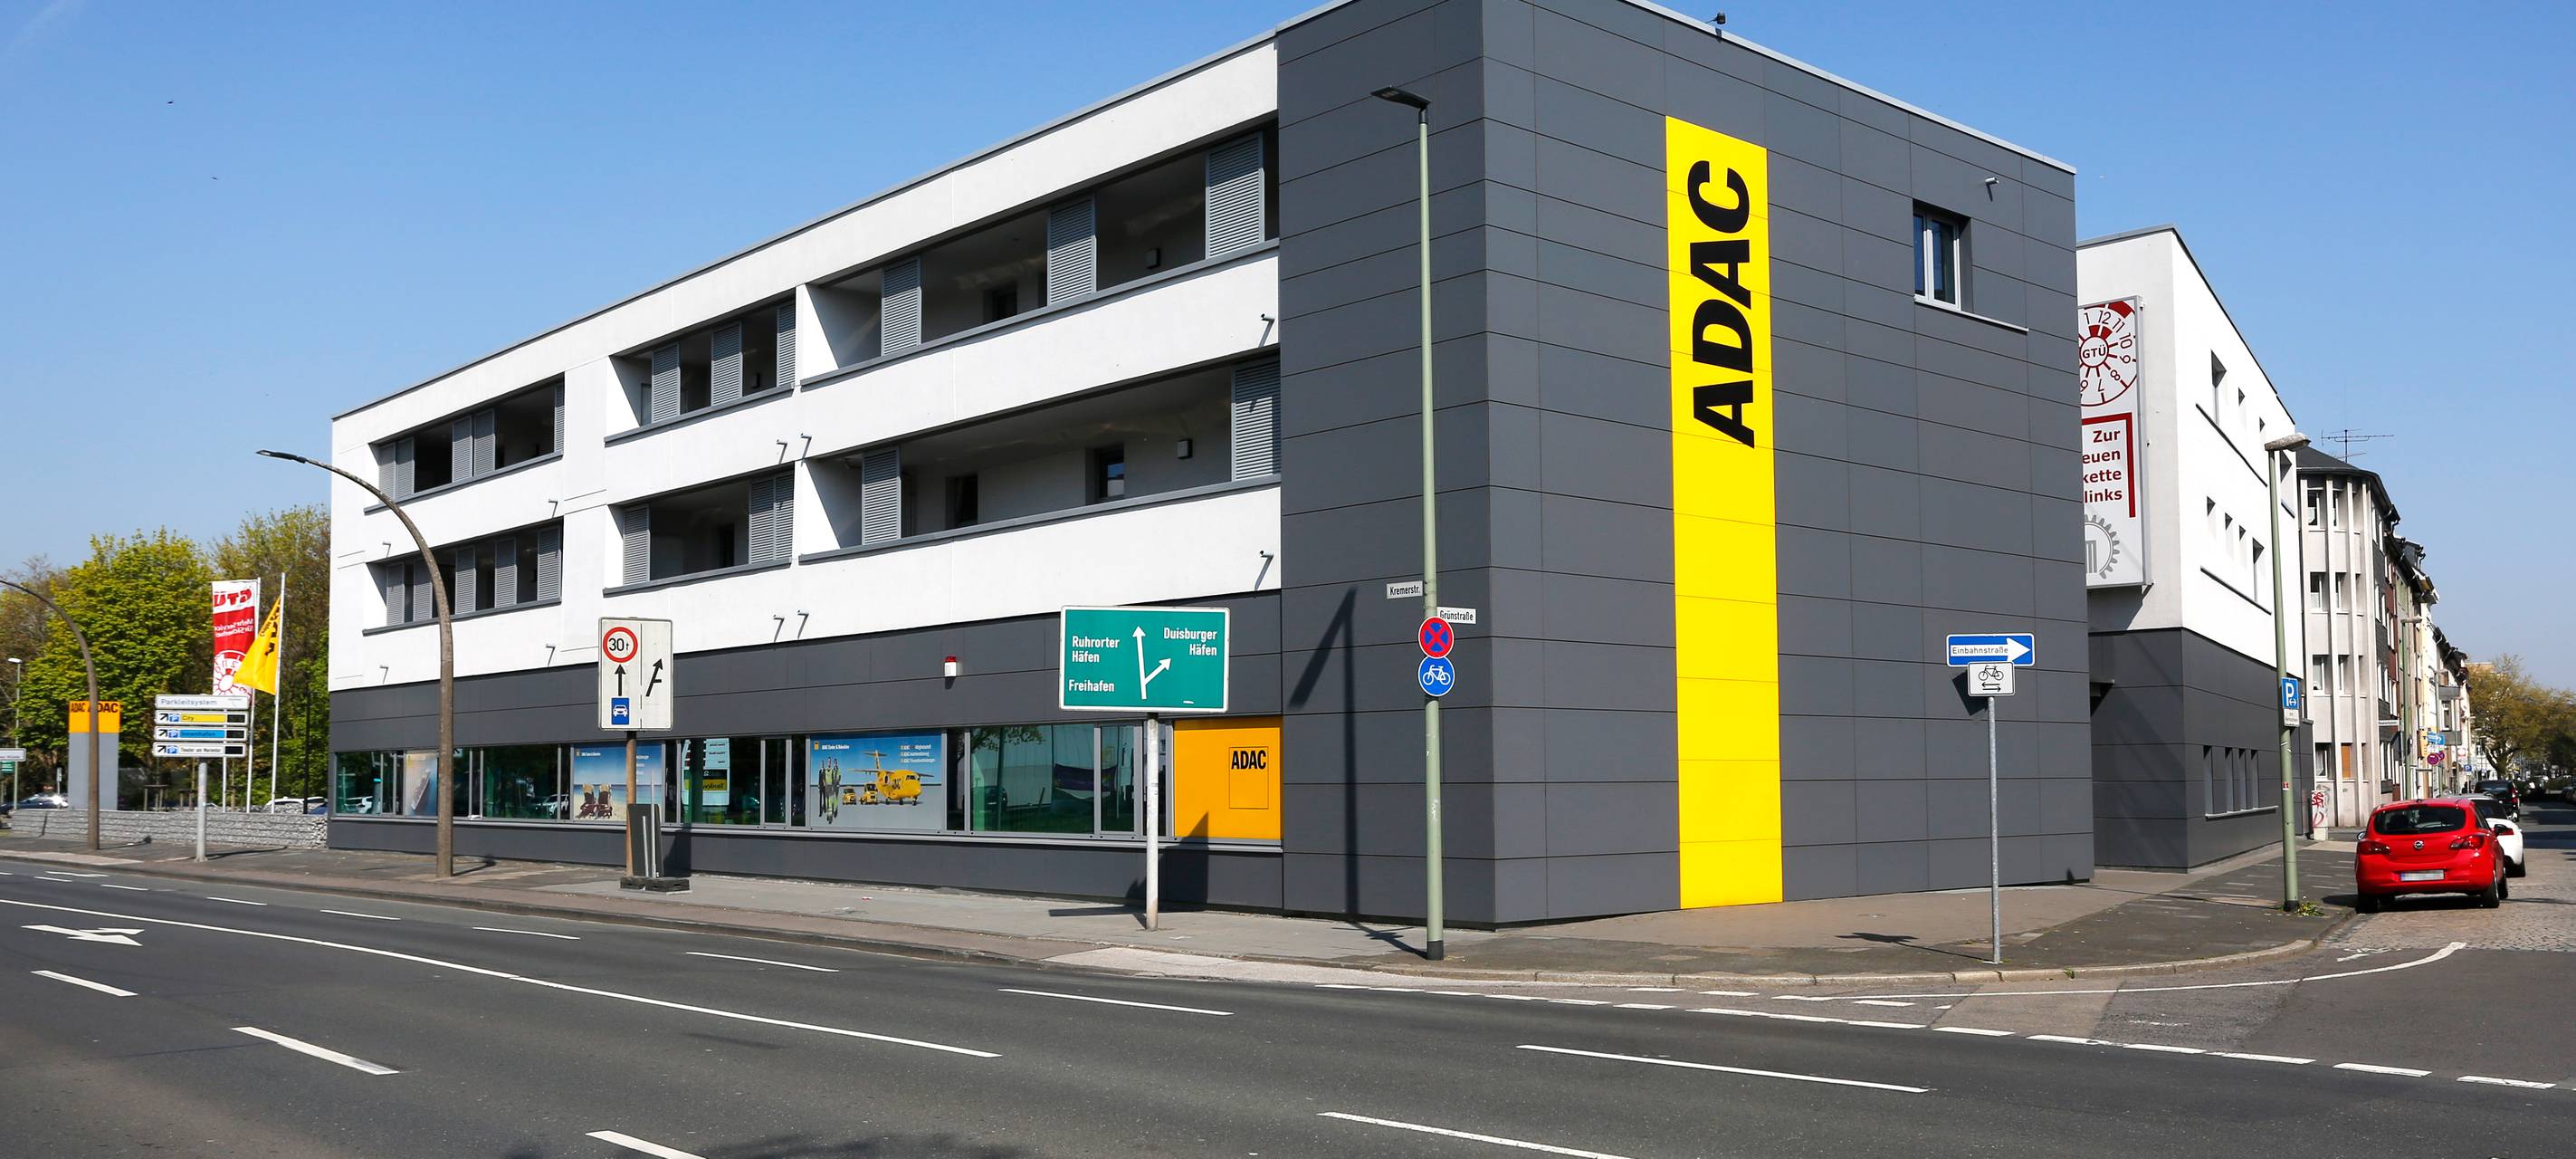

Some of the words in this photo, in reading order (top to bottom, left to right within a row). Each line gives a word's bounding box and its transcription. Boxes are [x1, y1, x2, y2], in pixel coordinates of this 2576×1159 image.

[1687, 160, 1755, 449] ADAC
[2098, 311, 2112, 325] 12
[2113, 318, 2125, 333] 11
[2119, 332, 2132, 350] 10
[2083, 344, 2106, 359] GTÜ
[2110, 369, 2121, 381] 8
[2093, 430, 2121, 443] Zur
[2082, 450, 2121, 464] euen
[2083, 470, 2122, 484] kette
[2085, 489, 2123, 503] links
[1389, 585, 1421, 596] Kremerstr.
[1439, 609, 1474, 621] Grünstraße
[1163, 627, 1217, 642] Duisburger
[608, 637, 625, 651] 30
[1072, 636, 1120, 648] Ruhrorter
[1072, 650, 1100, 663] Häfen
[1189, 643, 1217, 656] Häfen
[1952, 647, 2008, 655] Einbahnstraße
[1068, 679, 1115, 692] Freihafen
[160, 698, 217, 706] Parkleitsystem
[1231, 750, 1266, 770] ADAC
